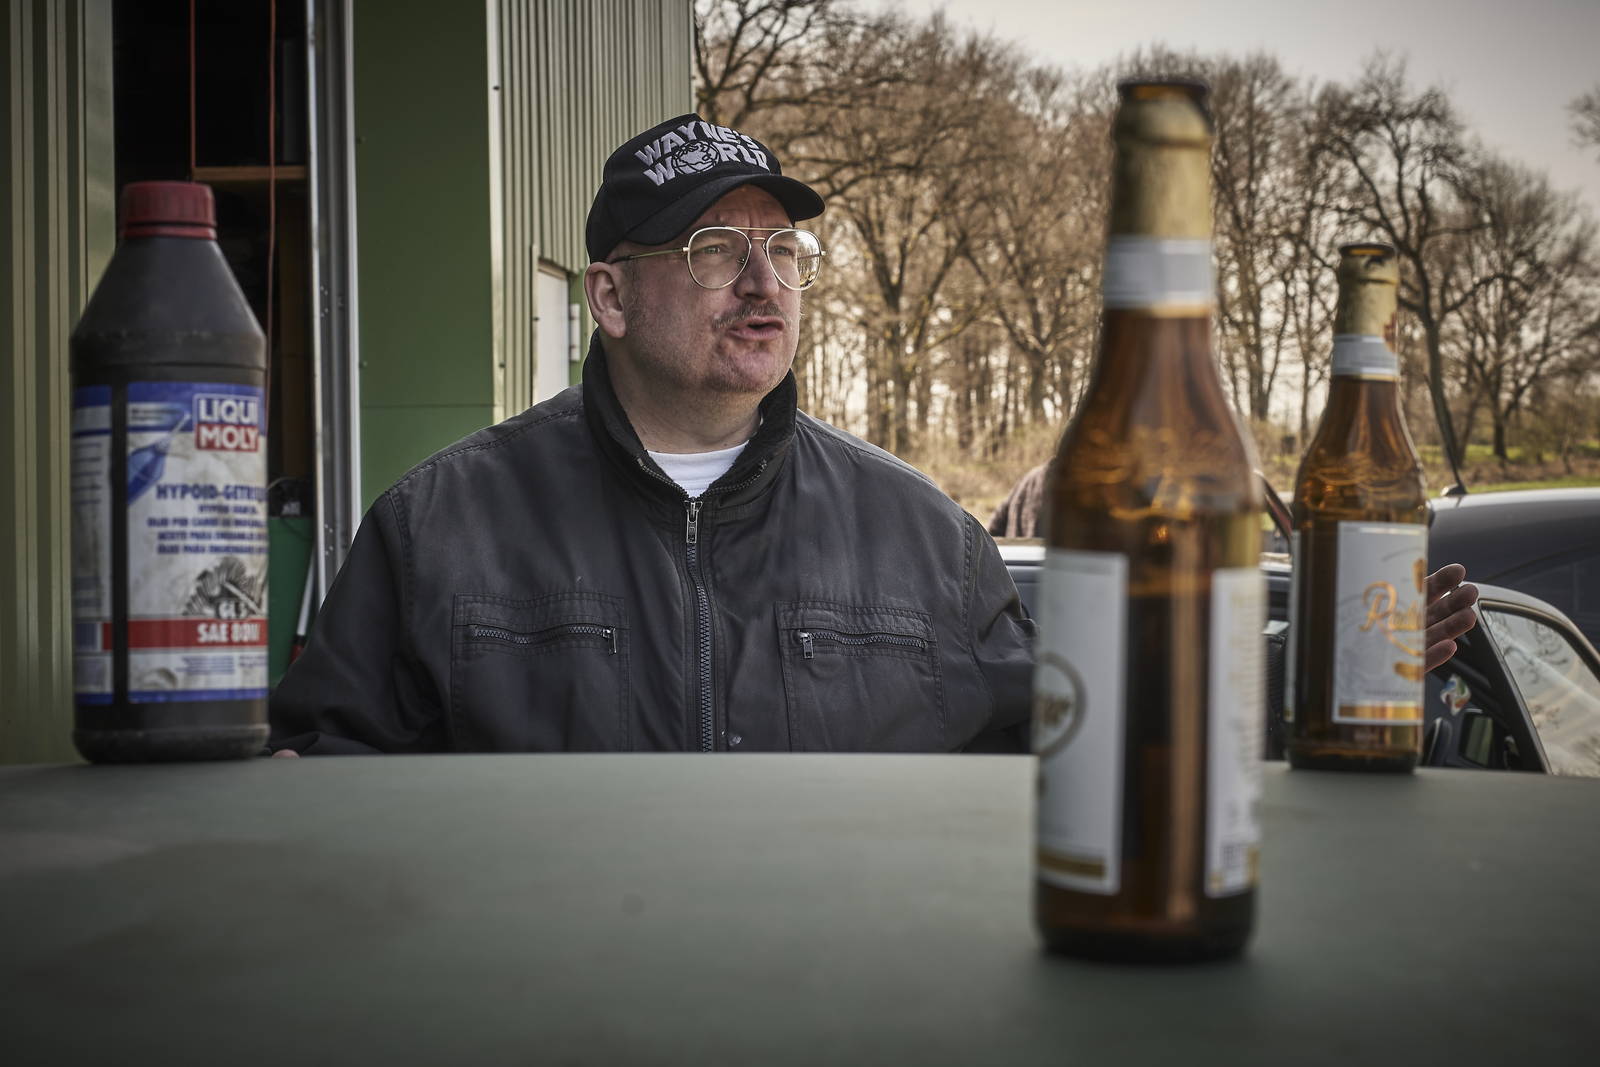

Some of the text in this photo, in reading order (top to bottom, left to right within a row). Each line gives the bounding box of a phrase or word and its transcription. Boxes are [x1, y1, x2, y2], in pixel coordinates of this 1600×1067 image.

[634, 121, 760, 167] WAYNE'S
[200, 400, 257, 423] LIQUI
[200, 427, 258, 449] MOLY
[197, 623, 229, 643] SAE
